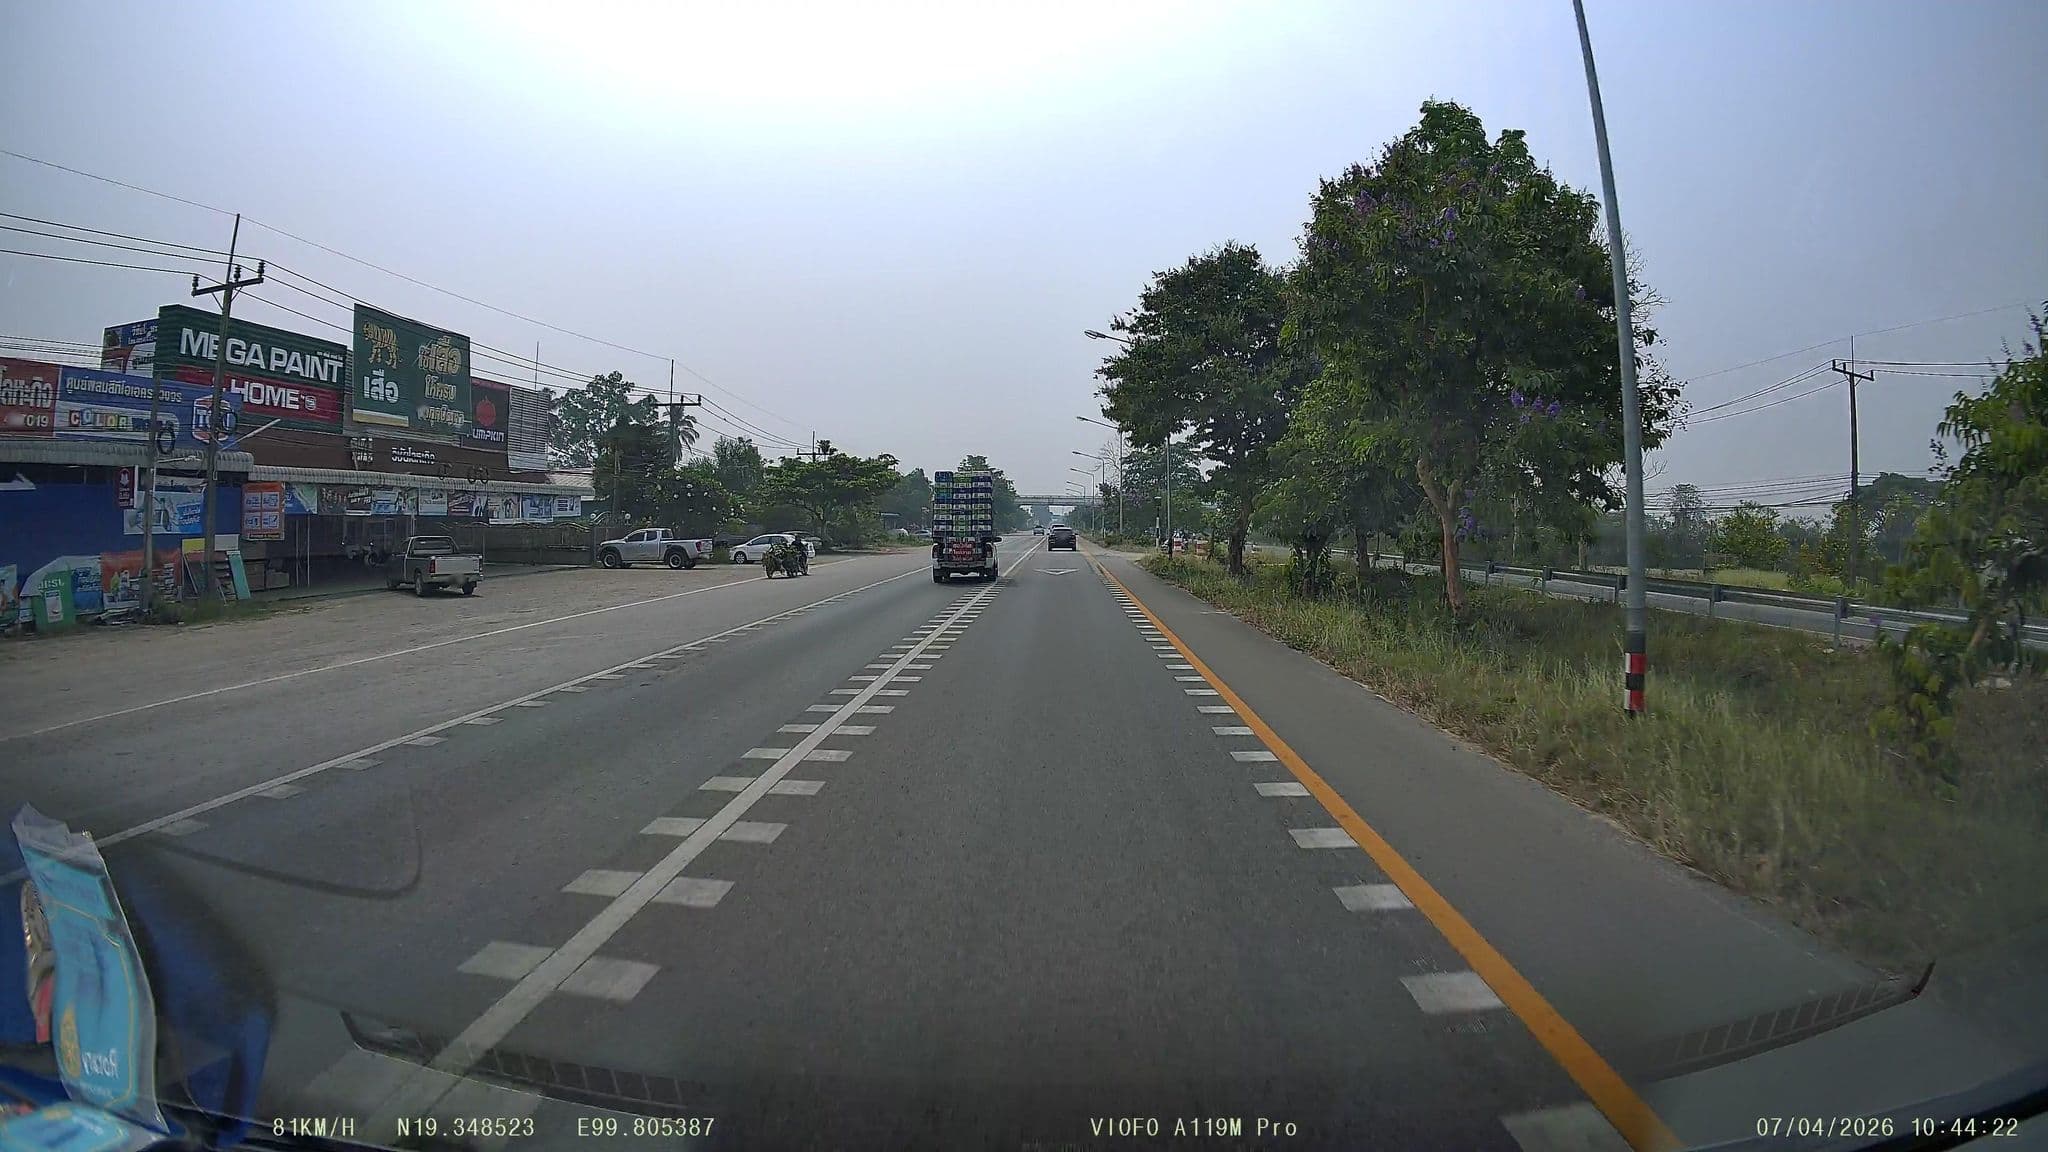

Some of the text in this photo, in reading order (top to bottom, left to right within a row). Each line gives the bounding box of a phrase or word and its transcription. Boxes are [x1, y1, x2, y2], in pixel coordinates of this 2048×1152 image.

[180, 327, 266, 370] MEGA
[269, 346, 344, 383] PAINT
[363, 368, 399, 404] เสือ
[69, 408, 130, 432] COLOR
[467, 426, 505, 442] UMPKIN
